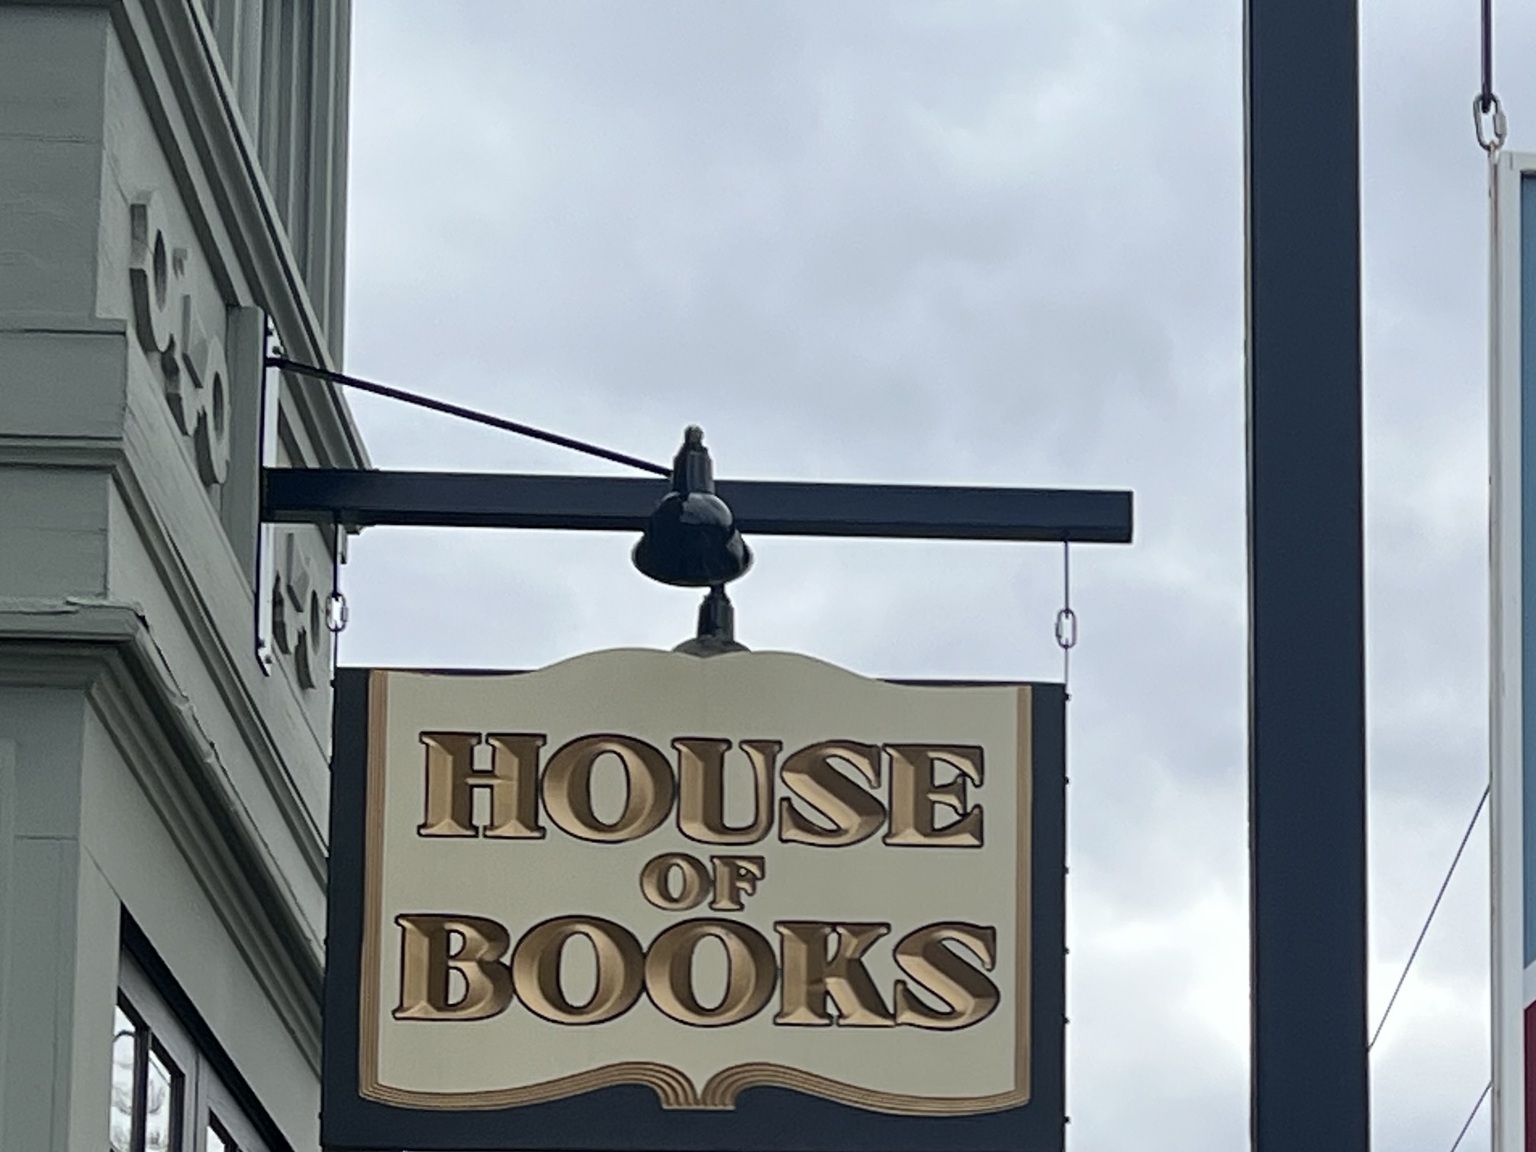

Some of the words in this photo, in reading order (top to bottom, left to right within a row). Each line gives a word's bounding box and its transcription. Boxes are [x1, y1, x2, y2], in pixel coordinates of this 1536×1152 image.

[416, 731, 984, 847] HOUSE
[640, 852, 765, 912] OF
[392, 914, 1000, 1031] BOOKS
